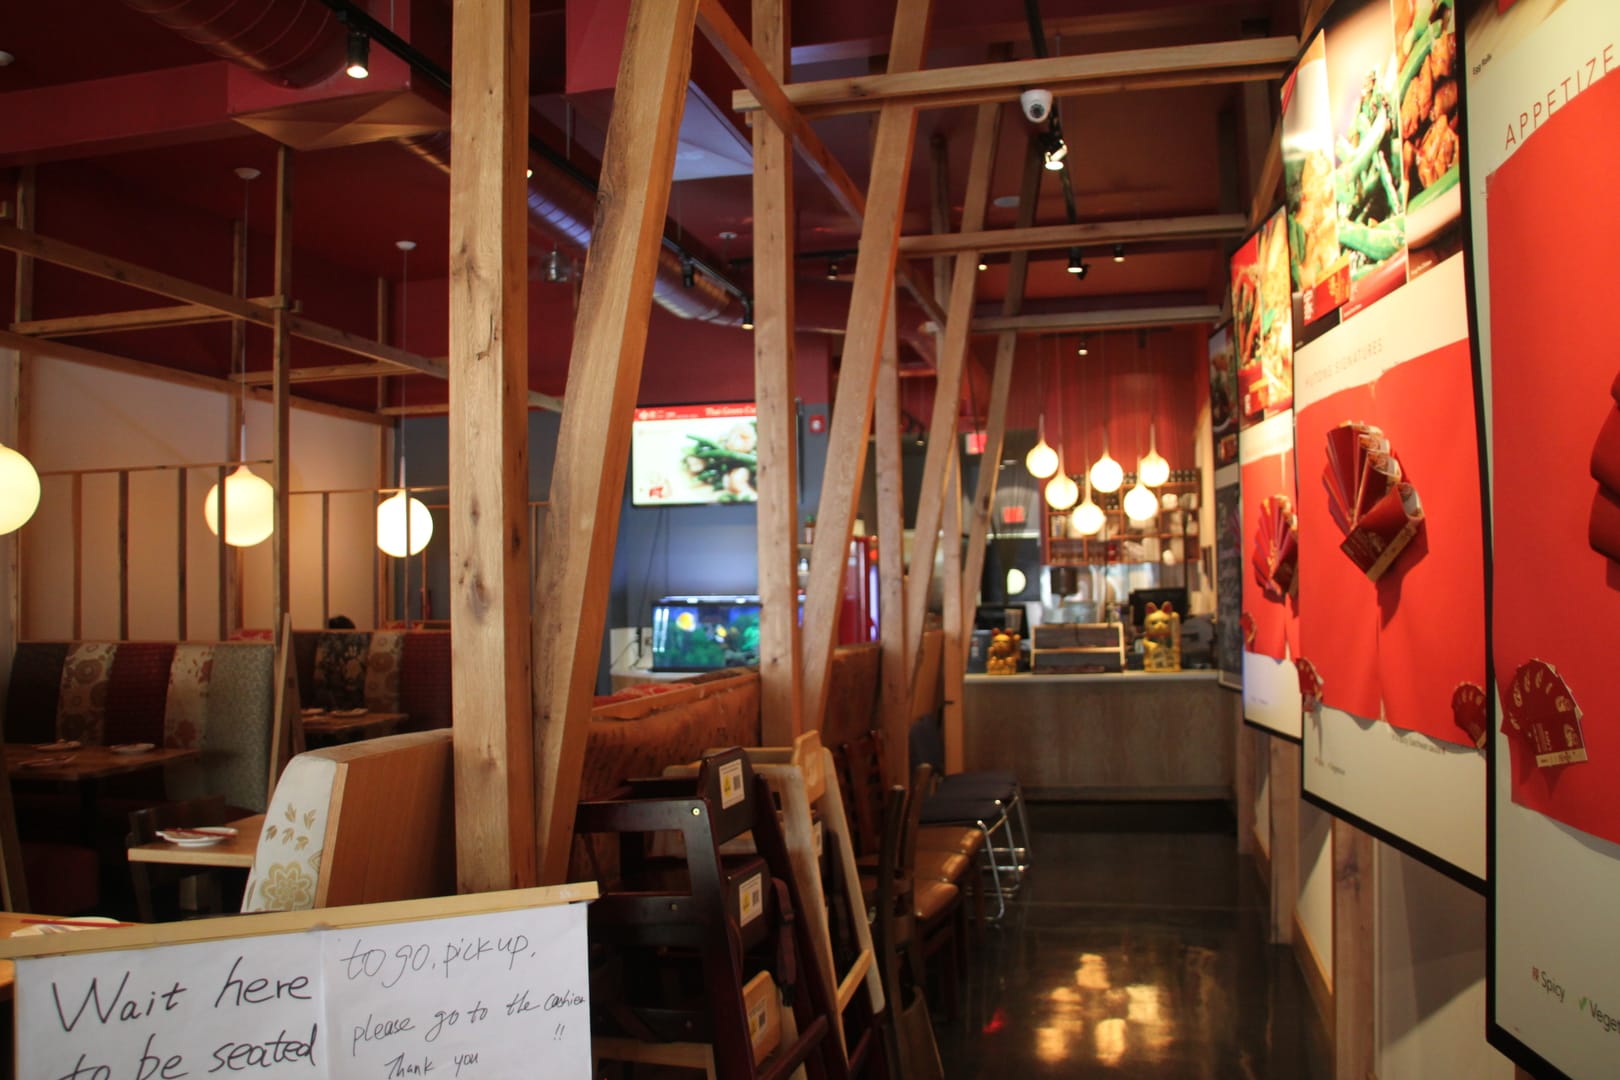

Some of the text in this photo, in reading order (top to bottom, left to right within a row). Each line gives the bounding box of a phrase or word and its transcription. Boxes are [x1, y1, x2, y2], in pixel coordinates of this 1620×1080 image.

[340, 939, 386, 980] to
[52, 955, 313, 1032] Wait here
[1541, 970, 1566, 1004] Spicy
[352, 1013, 416, 1057] please
[424, 1010, 460, 1043] go
[467, 1000, 489, 1024] to
[506, 989, 541, 1016] the
[57, 1023, 318, 1080] to be seated
[384, 1052, 479, 1080] Thank you
